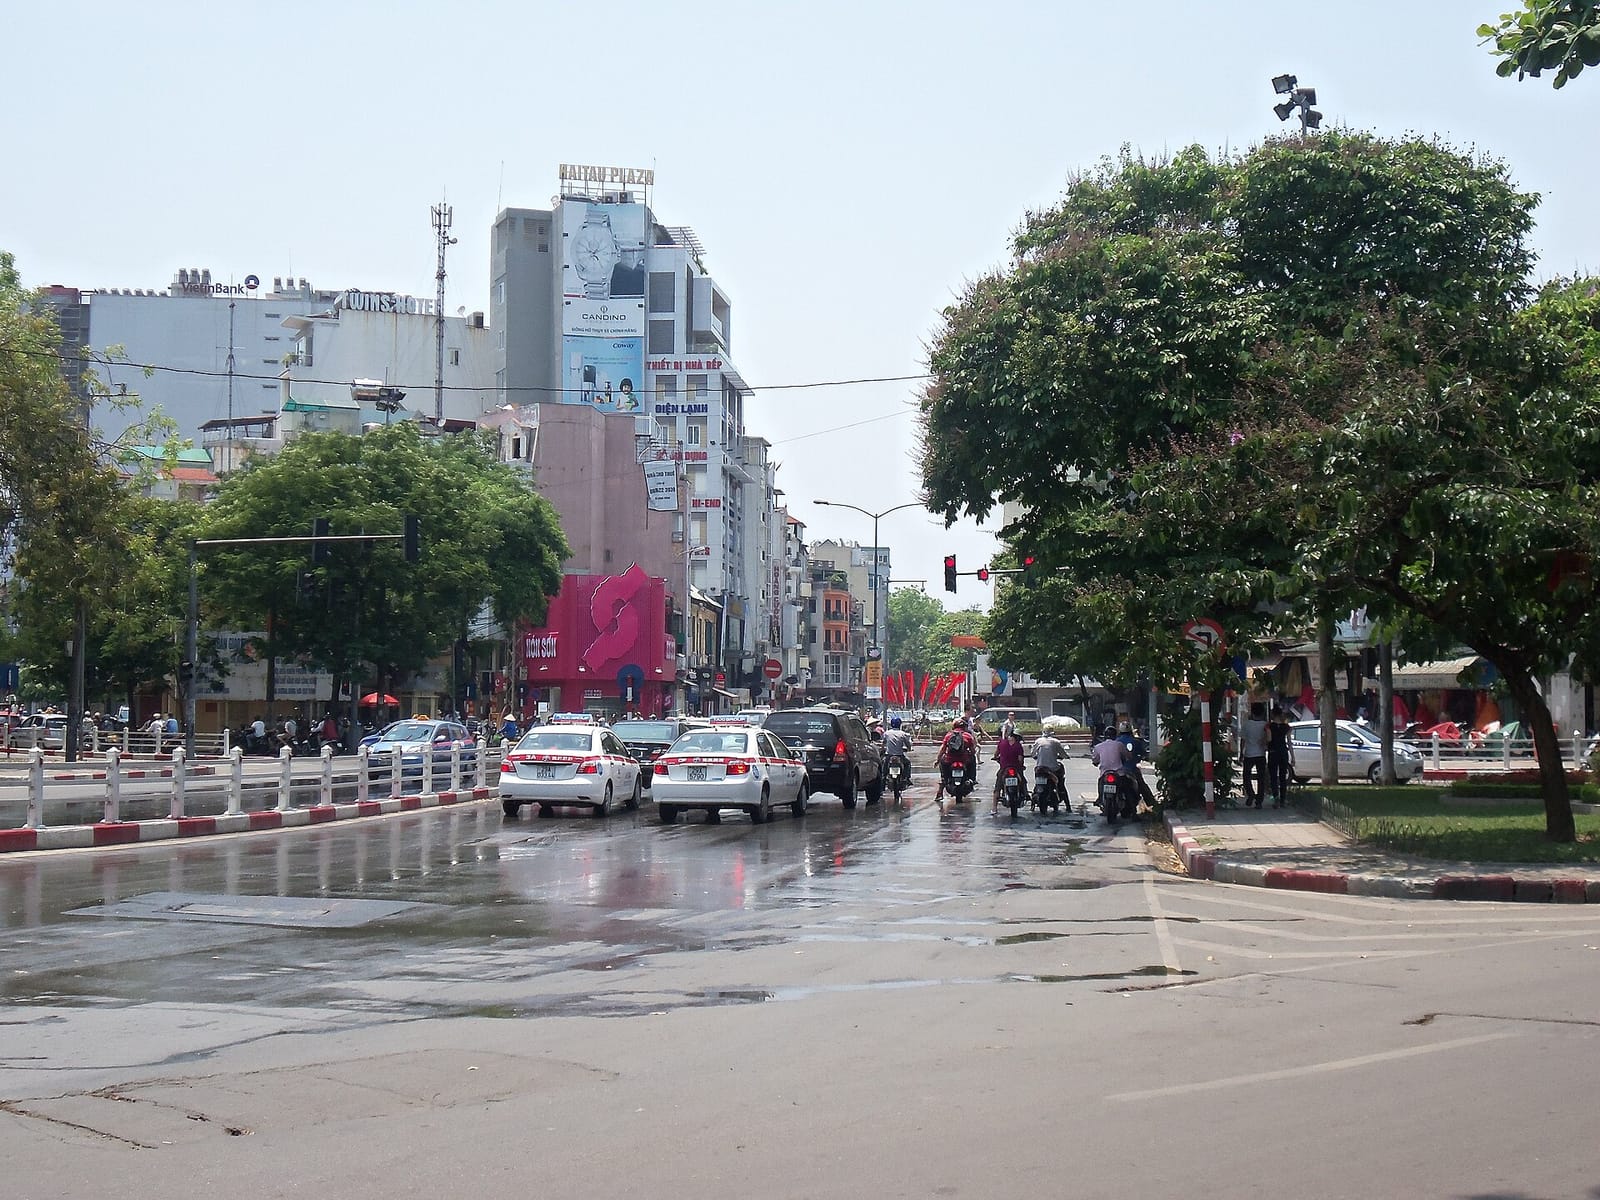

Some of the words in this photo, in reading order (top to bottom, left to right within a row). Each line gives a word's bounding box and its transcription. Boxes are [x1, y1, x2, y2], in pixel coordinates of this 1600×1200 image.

[559, 164, 606, 182] HAITAU
[610, 167, 654, 185] PLAZA
[182, 282, 244, 294] VietinBank
[582, 313, 627, 321] CANDINO
[647, 357, 671, 370] THIẾT
[655, 402, 679, 415] ĐIỆN
[680, 404, 708, 415] LẠNH
